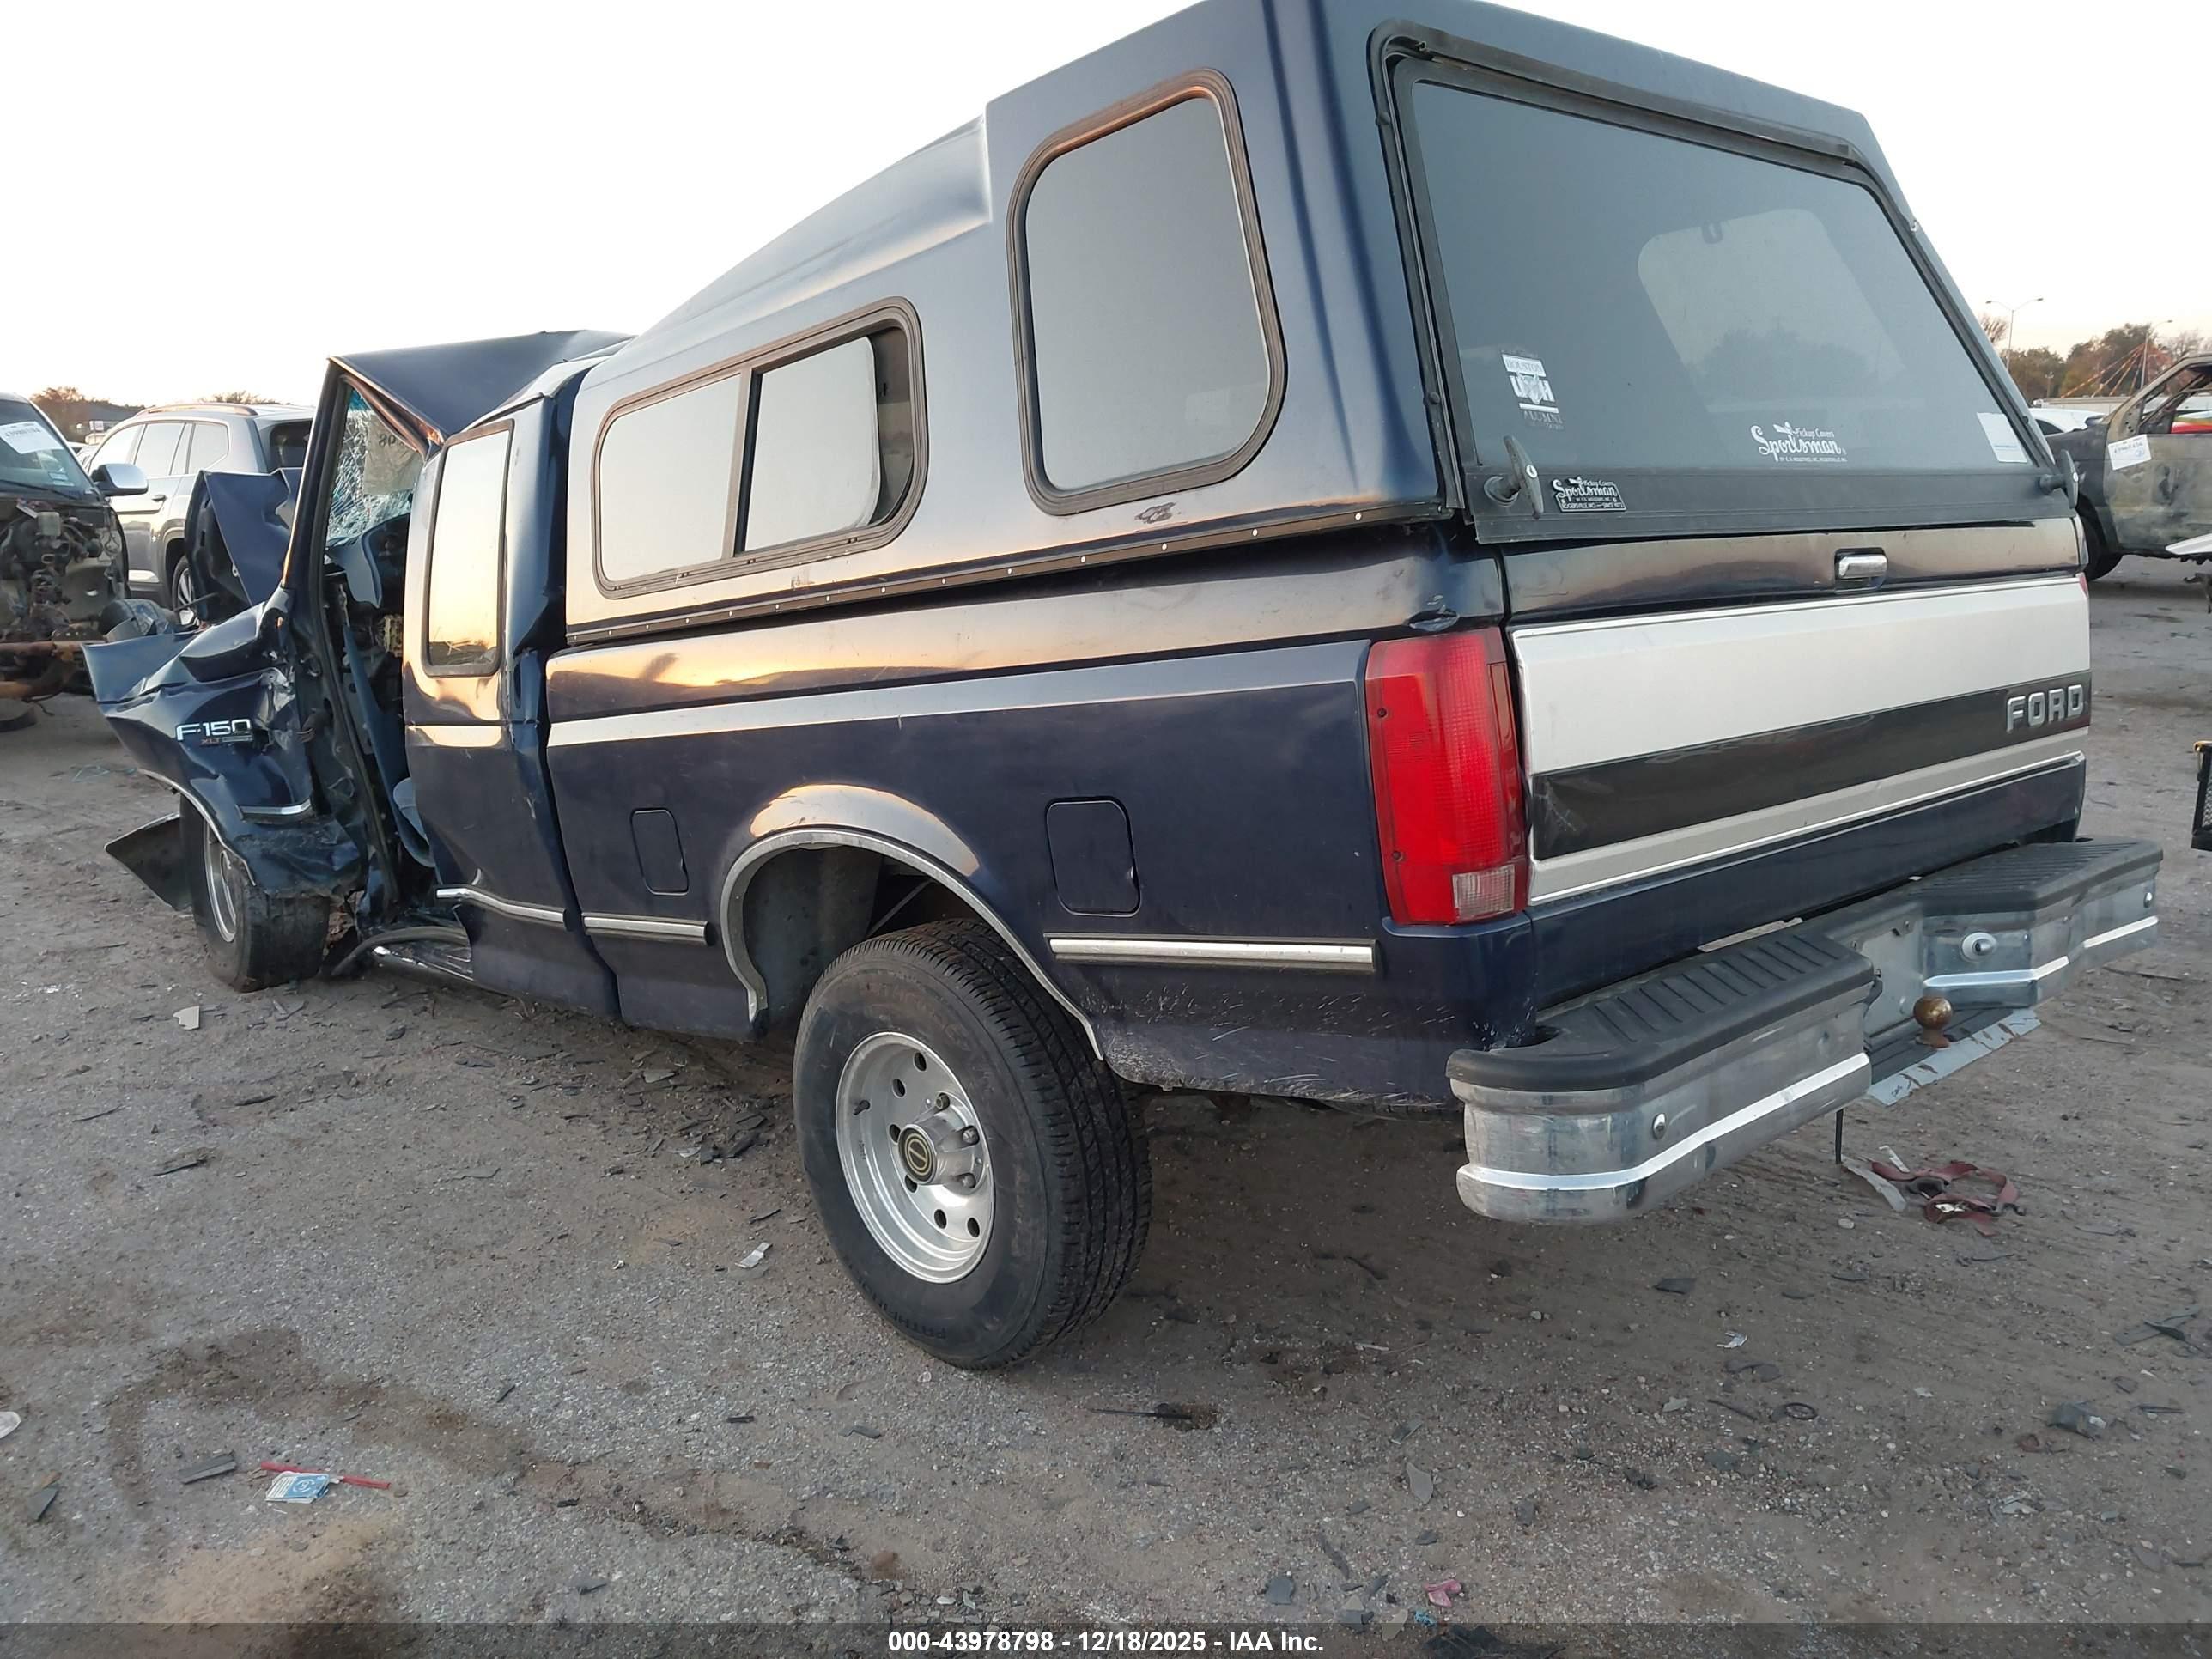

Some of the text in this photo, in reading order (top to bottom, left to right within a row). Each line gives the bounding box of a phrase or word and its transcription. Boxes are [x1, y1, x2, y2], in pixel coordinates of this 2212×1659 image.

[1750, 423, 1842, 462] Sportsman
[1552, 477, 1619, 502] Sportsman
[2006, 684, 2084, 733] FORD
